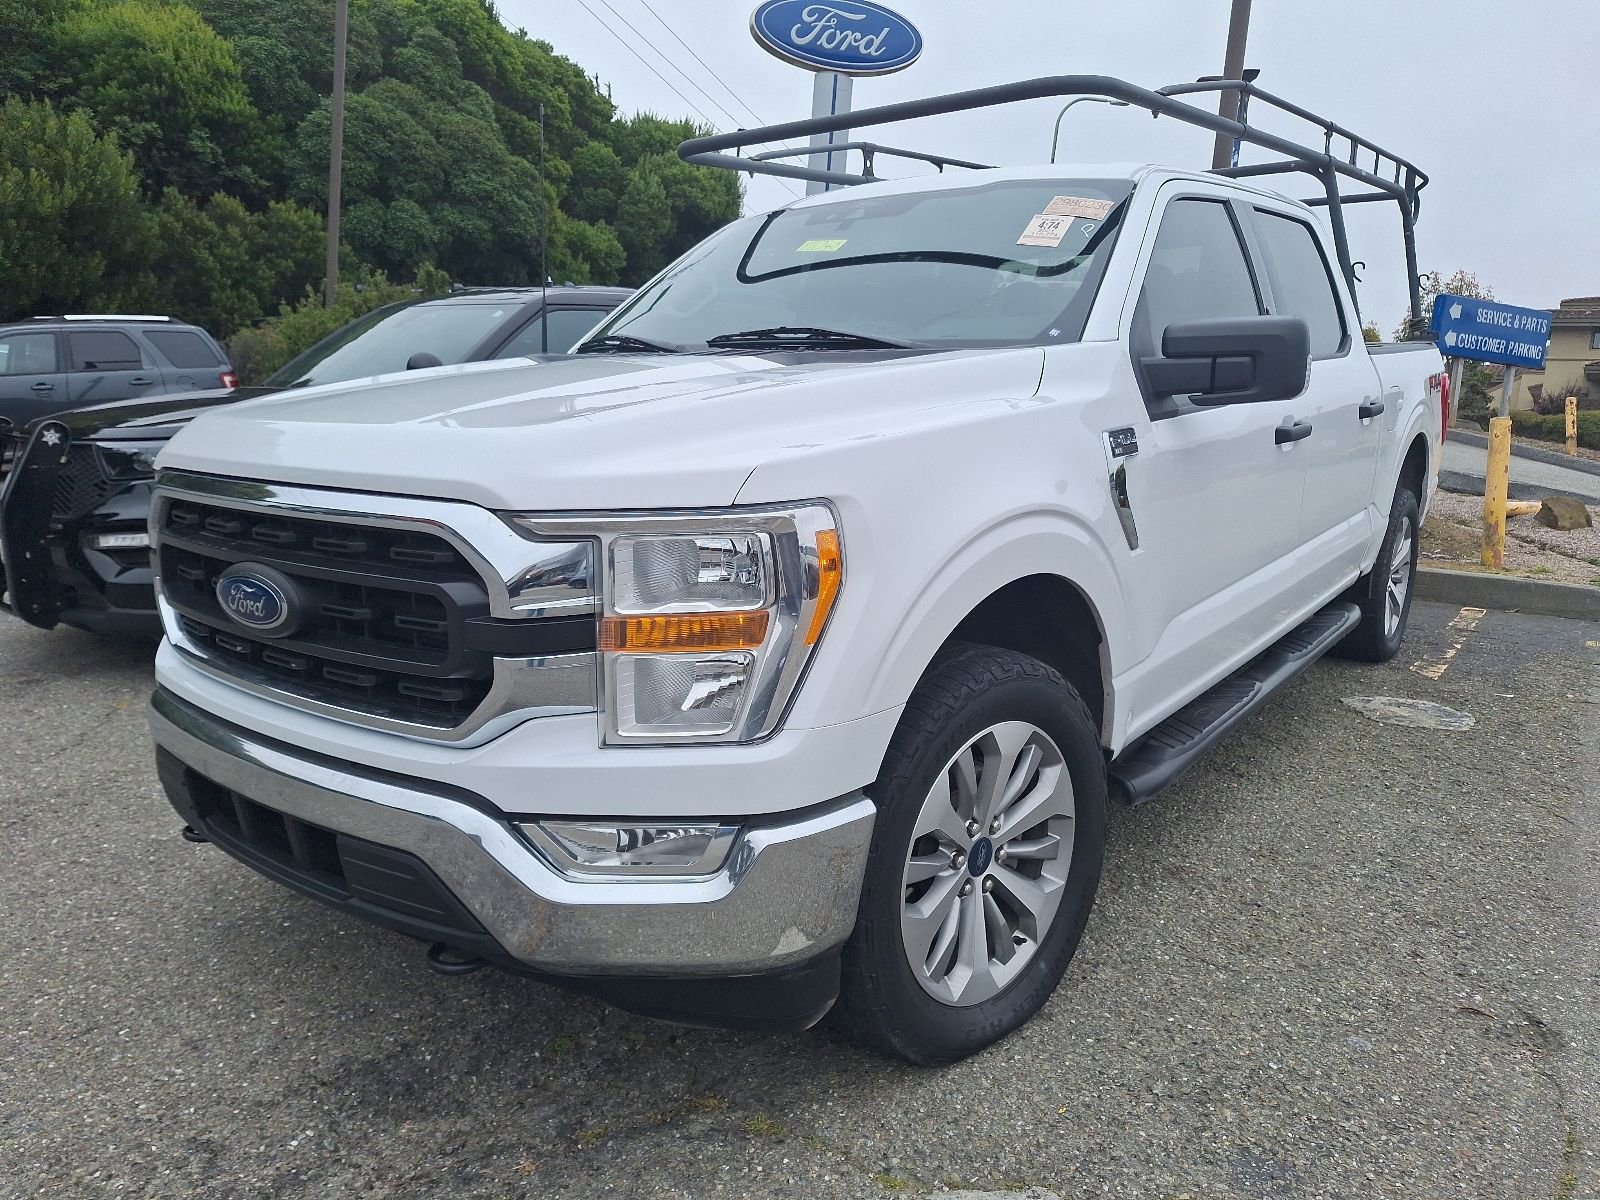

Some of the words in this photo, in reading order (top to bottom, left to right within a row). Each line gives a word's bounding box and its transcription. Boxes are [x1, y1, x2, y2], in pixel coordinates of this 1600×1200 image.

[790, 5, 890, 56] Ford
[1476, 308, 1512, 328] SERVICE
[1513, 314, 1520, 329] &
[1520, 315, 1548, 334] PARTS
[1457, 333, 1506, 354] CUSTOMER
[1507, 342, 1543, 360] PARKING
[228, 583, 266, 617] Ford
